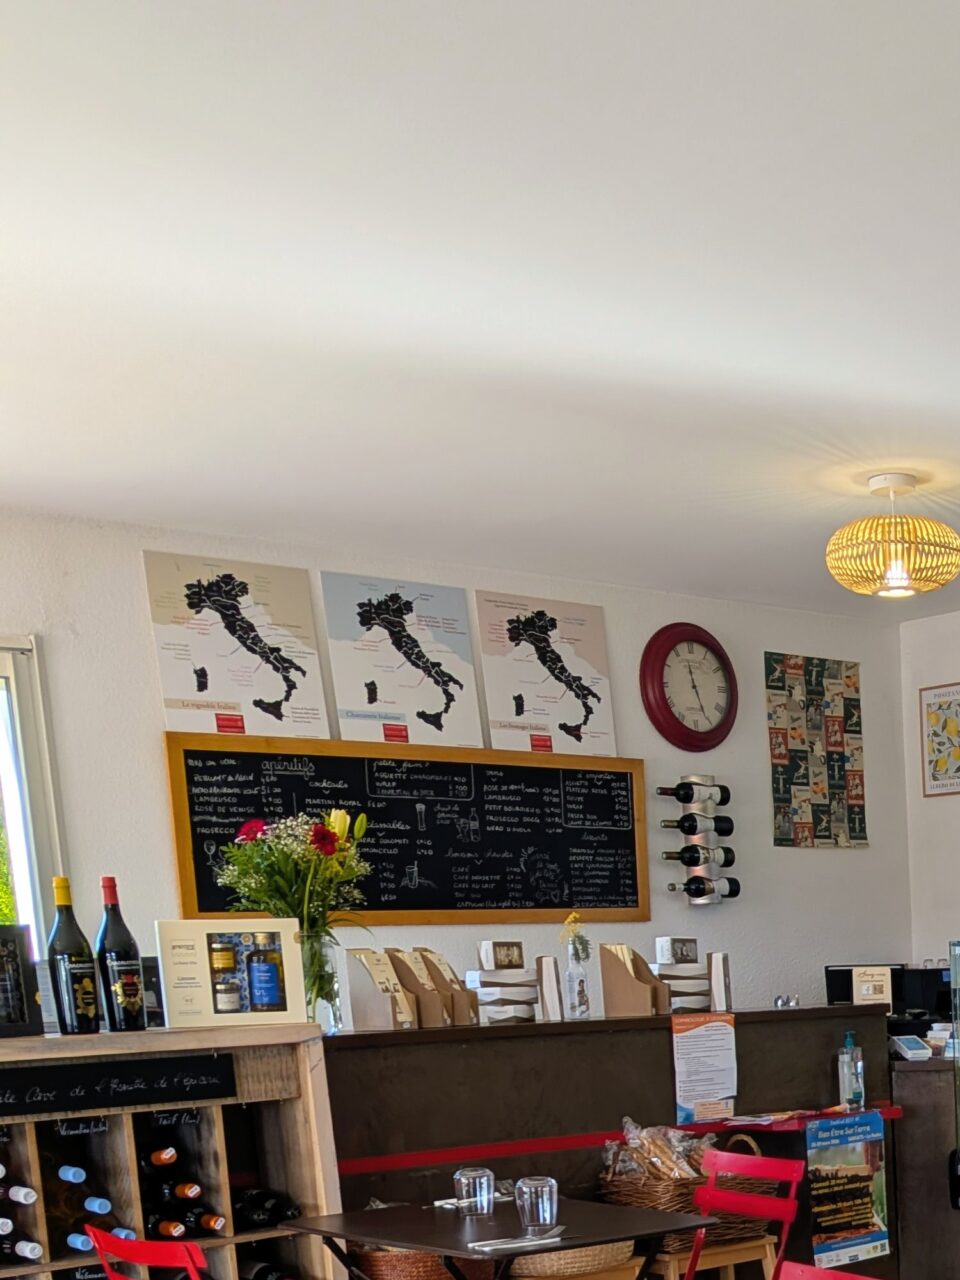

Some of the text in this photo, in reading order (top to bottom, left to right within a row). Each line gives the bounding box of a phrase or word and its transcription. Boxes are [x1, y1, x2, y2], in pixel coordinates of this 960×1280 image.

[261, 757, 316, 780] apéritifs
[194, 796, 238, 804] LAMBRUSCO
[306, 798, 336, 806] MARTINI
[486, 815, 520, 823] PROSECCO
[196, 826, 236, 834] PROSECCO
[70, 1085, 86, 1097] de
[844, 1127, 855, 1135] Sur
